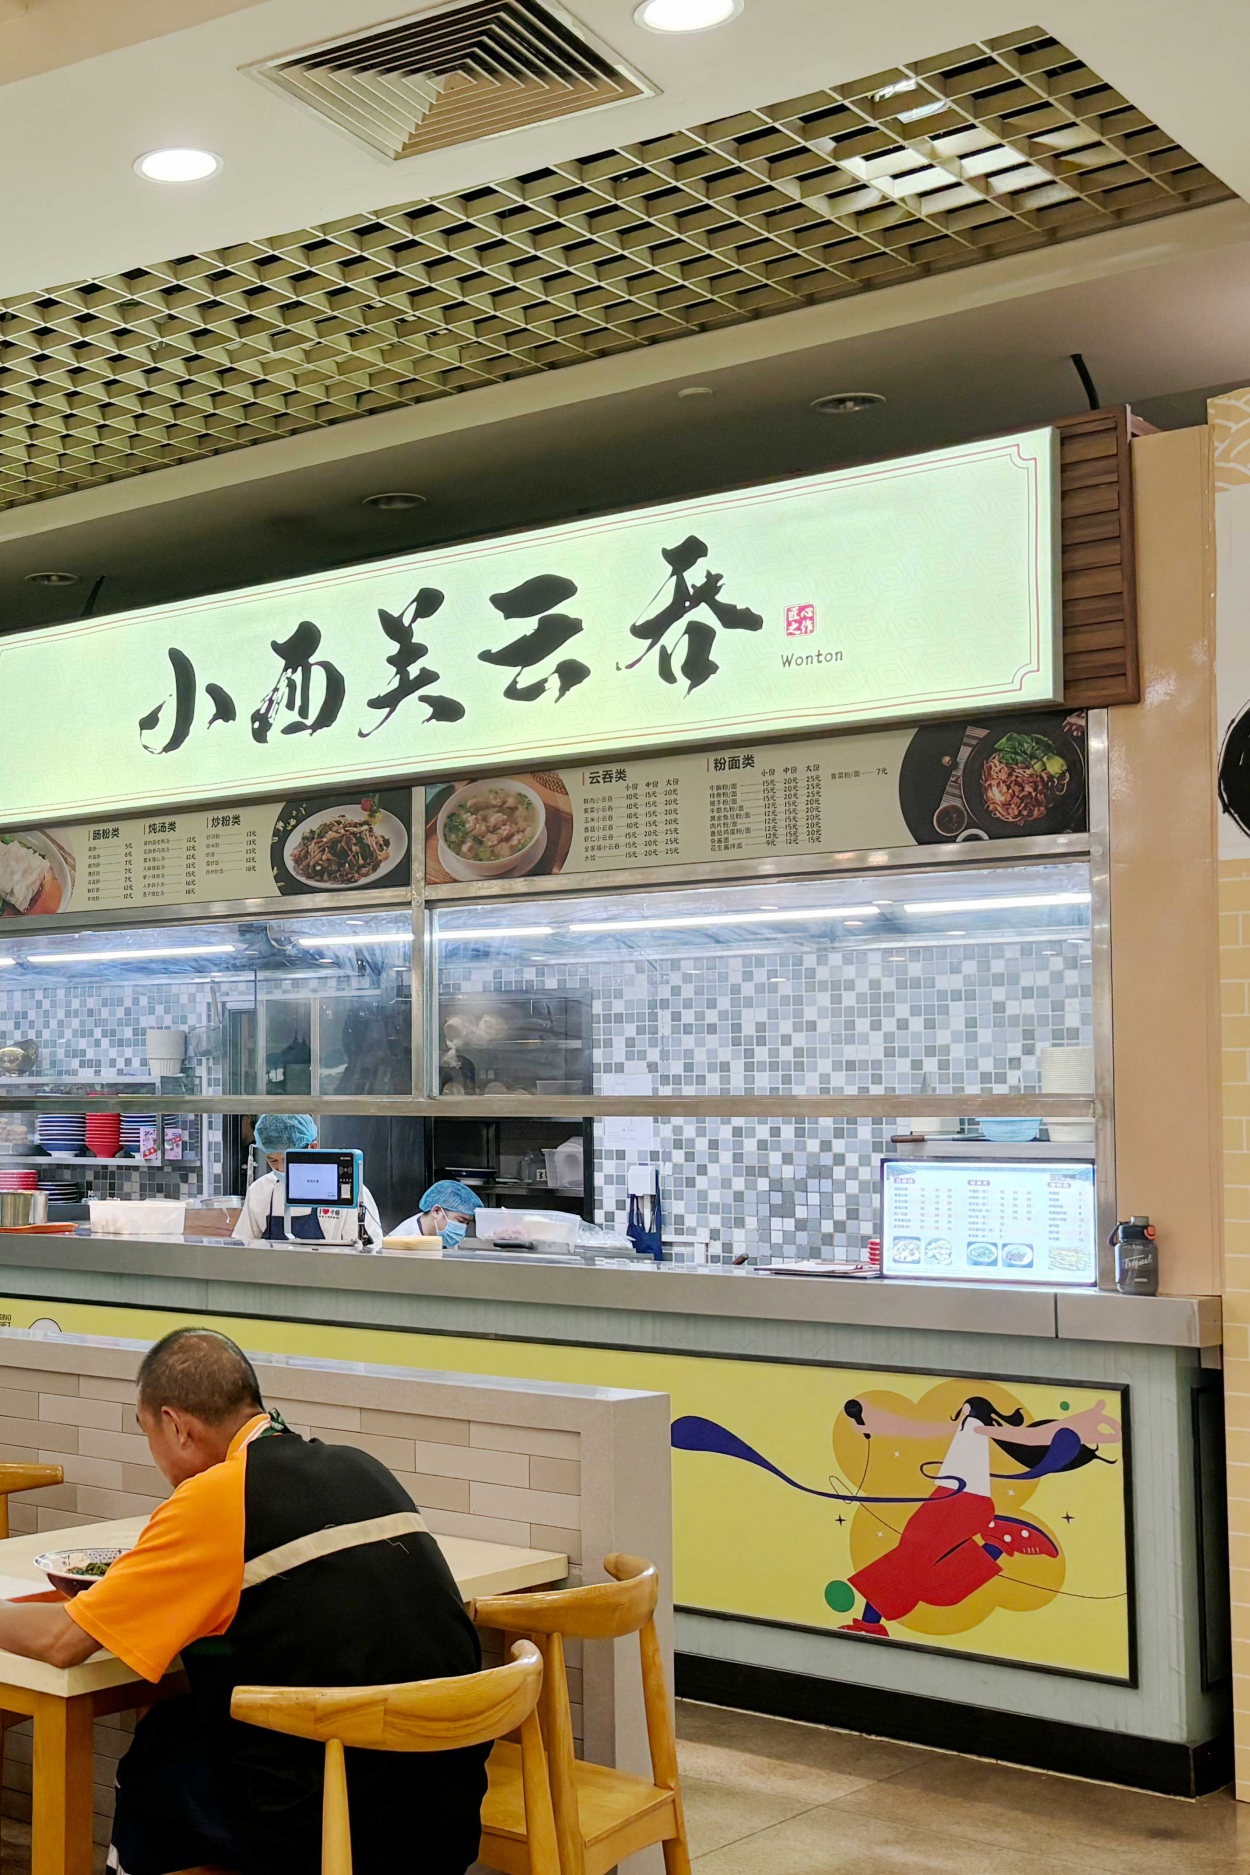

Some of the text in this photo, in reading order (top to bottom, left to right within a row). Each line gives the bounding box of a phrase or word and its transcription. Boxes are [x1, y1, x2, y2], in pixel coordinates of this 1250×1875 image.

[781, 649, 843, 668] Wonton
[714, 754, 755, 771] 粉面类
[589, 768, 627, 785] 云吞类
[876, 767, 888, 775] 7元
[625, 783, 638, 791] 小份
[666, 778, 679, 786] 大份
[211, 814, 241, 828] 炒粉类
[584, 815, 613, 823] 玉米小云吞
[93, 827, 120, 840] 肠粉类
[148, 821, 177, 834] 炖汤类
[584, 825, 613, 833] 香菇小云吞
[584, 834, 613, 842] 虾仁小云吞
[585, 843, 619, 852] 全家福小云吞
[1123, 1254, 1152, 1269] Tropical
